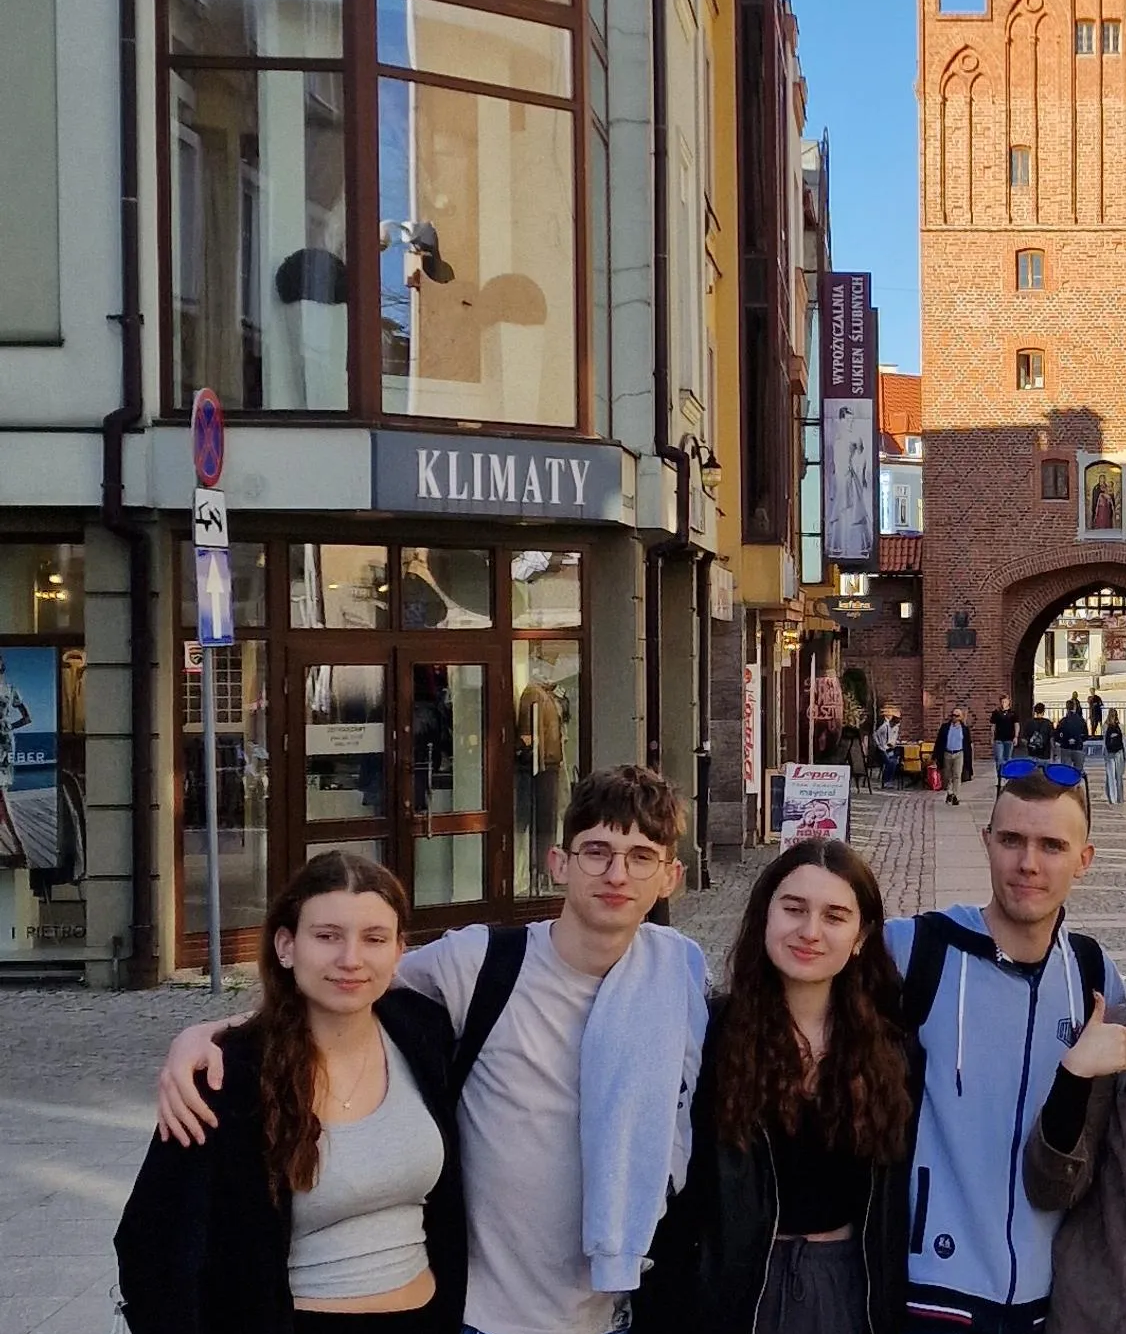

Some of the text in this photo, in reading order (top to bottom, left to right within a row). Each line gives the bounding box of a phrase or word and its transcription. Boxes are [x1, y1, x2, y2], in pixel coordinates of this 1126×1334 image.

[830, 284, 845, 385] WYPOŻYCZALNIA
[849, 276, 864, 395] SUKIEN ŚLUBNYCH
[416, 448, 591, 505] KLIMATY
